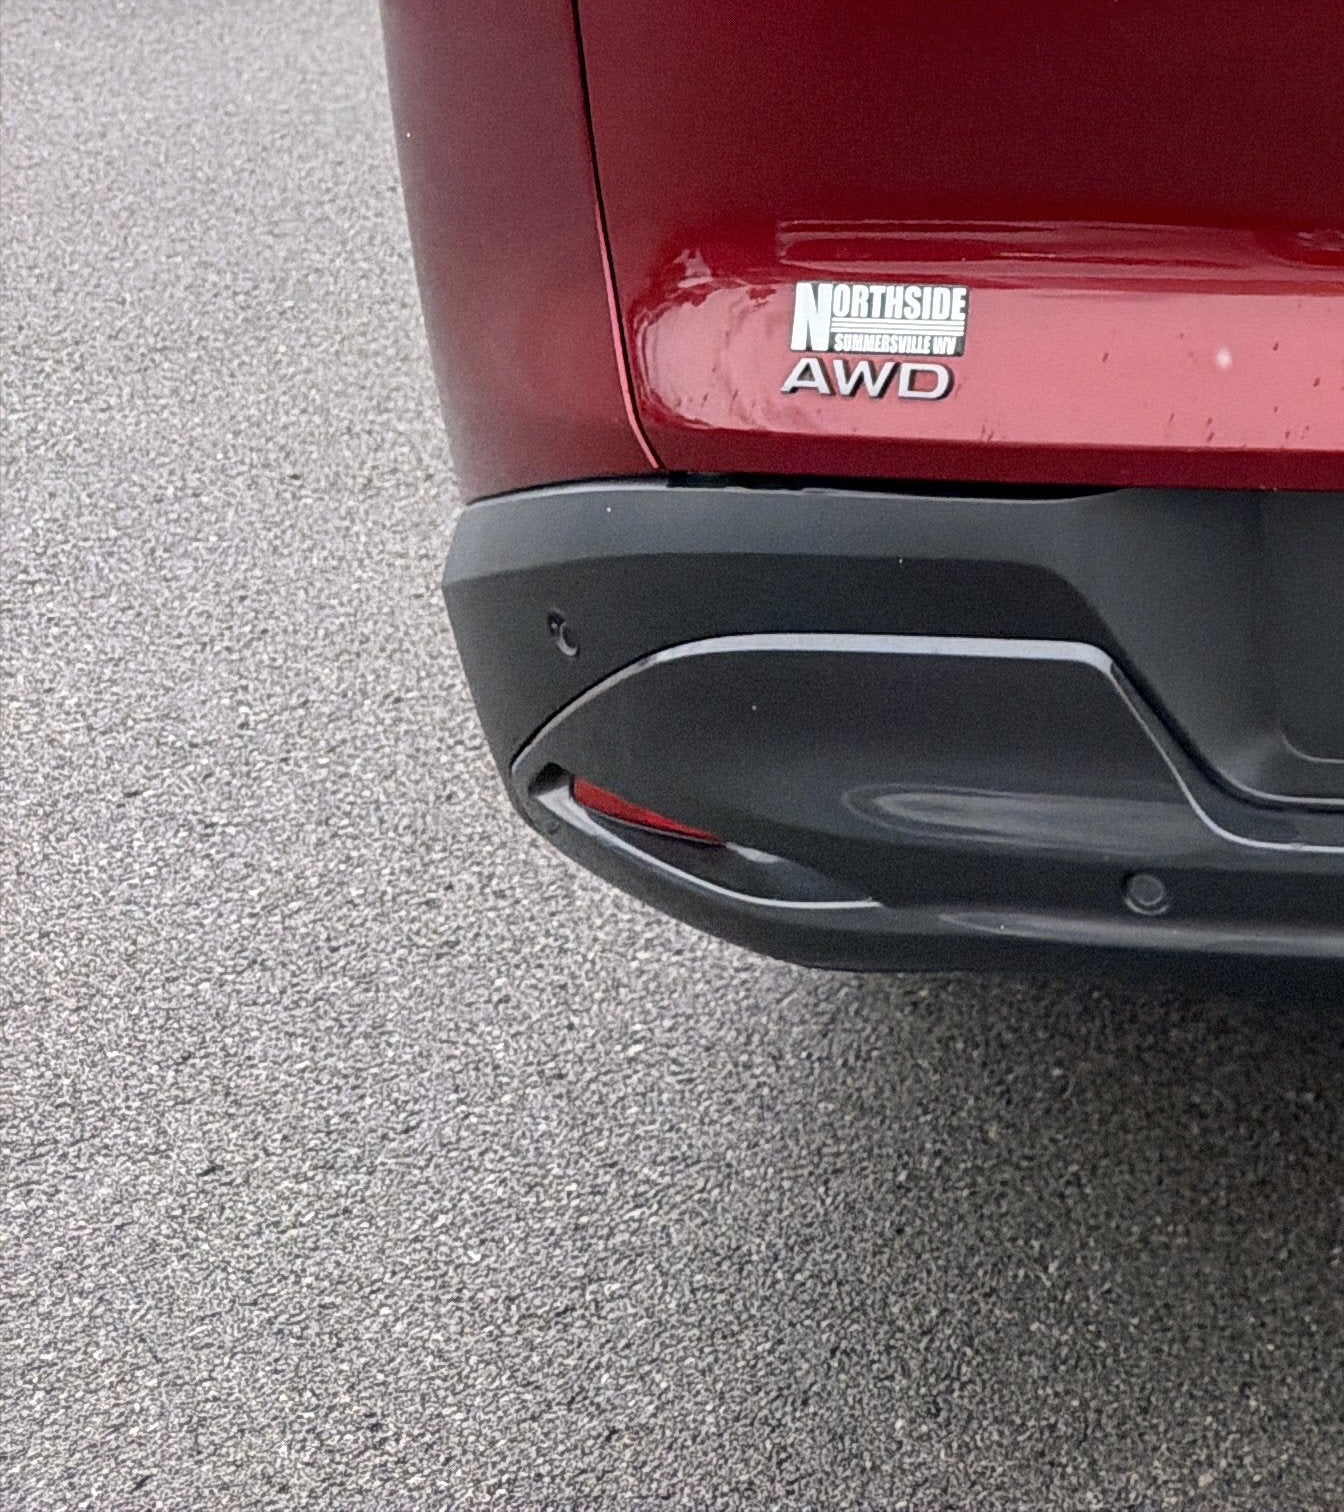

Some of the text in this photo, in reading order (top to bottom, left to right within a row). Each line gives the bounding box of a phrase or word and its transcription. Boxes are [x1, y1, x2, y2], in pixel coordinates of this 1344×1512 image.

[791, 282, 967, 351] NORTHSIDE
[834, 333, 957, 355] SUMMERSVILLE WV
[780, 357, 955, 400] AWD
